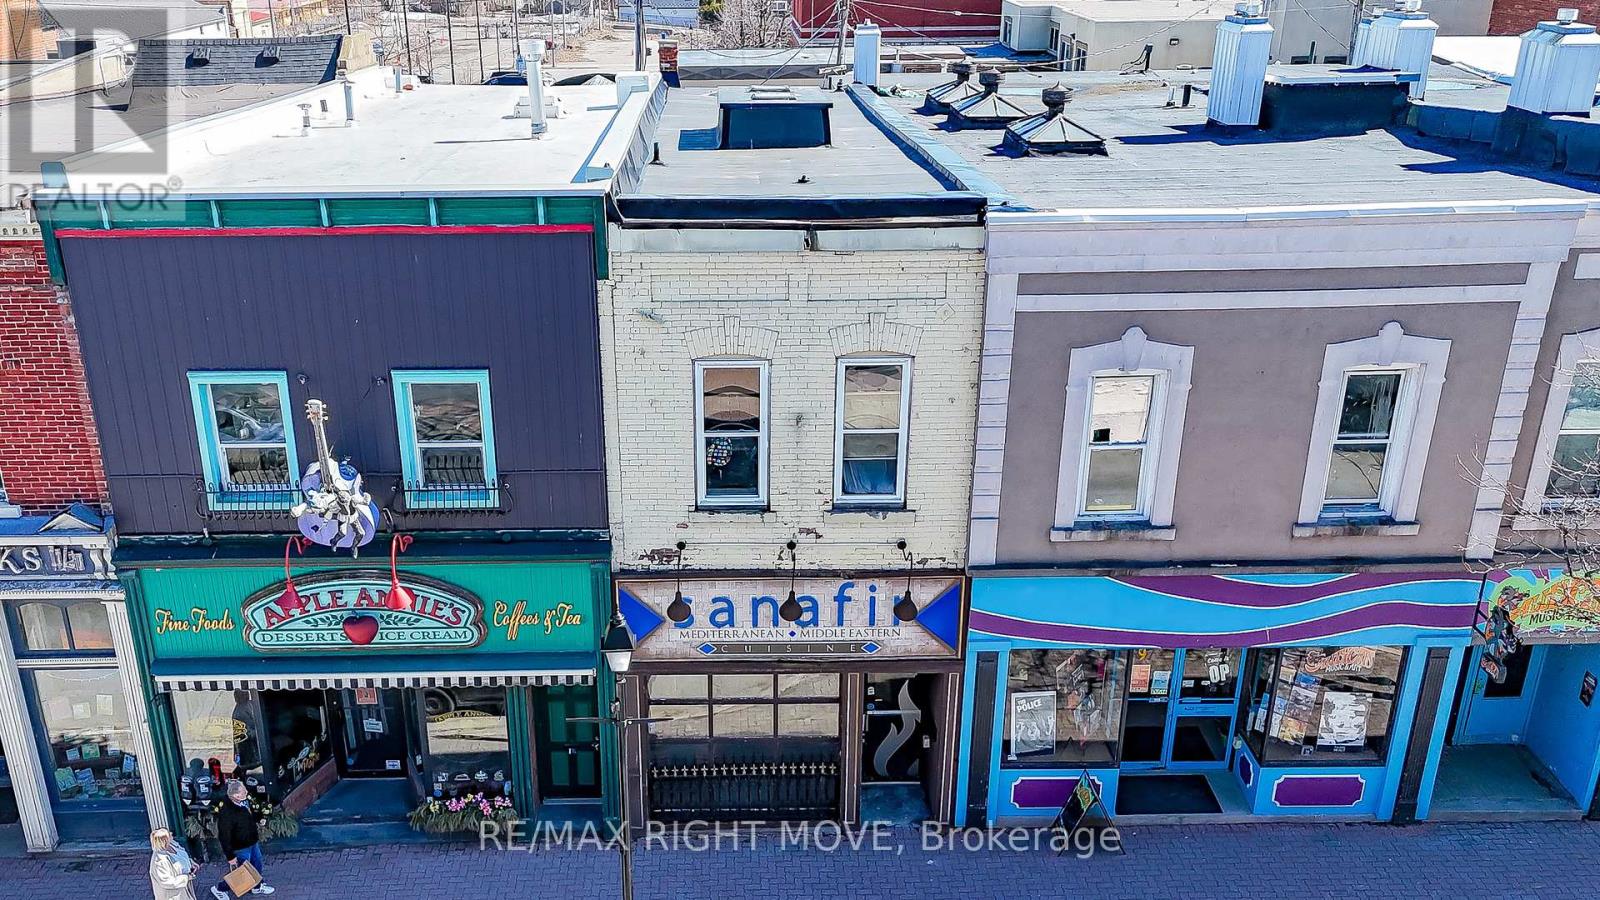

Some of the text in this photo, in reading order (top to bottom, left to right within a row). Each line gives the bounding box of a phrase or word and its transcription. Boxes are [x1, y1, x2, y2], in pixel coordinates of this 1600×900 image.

[155, 608, 235, 634] Fine Foods
[494, 600, 540, 641] Coffees
[556, 603, 581, 628] Tea
[261, 630, 468, 643] DESSERTS ICE CREAM
[679, 628, 901, 639] MEDITERRANEAN MIDDLE EASTERN
[721, 644, 857, 653] CUISINE
[1016, 698, 1042, 713] POLICE
